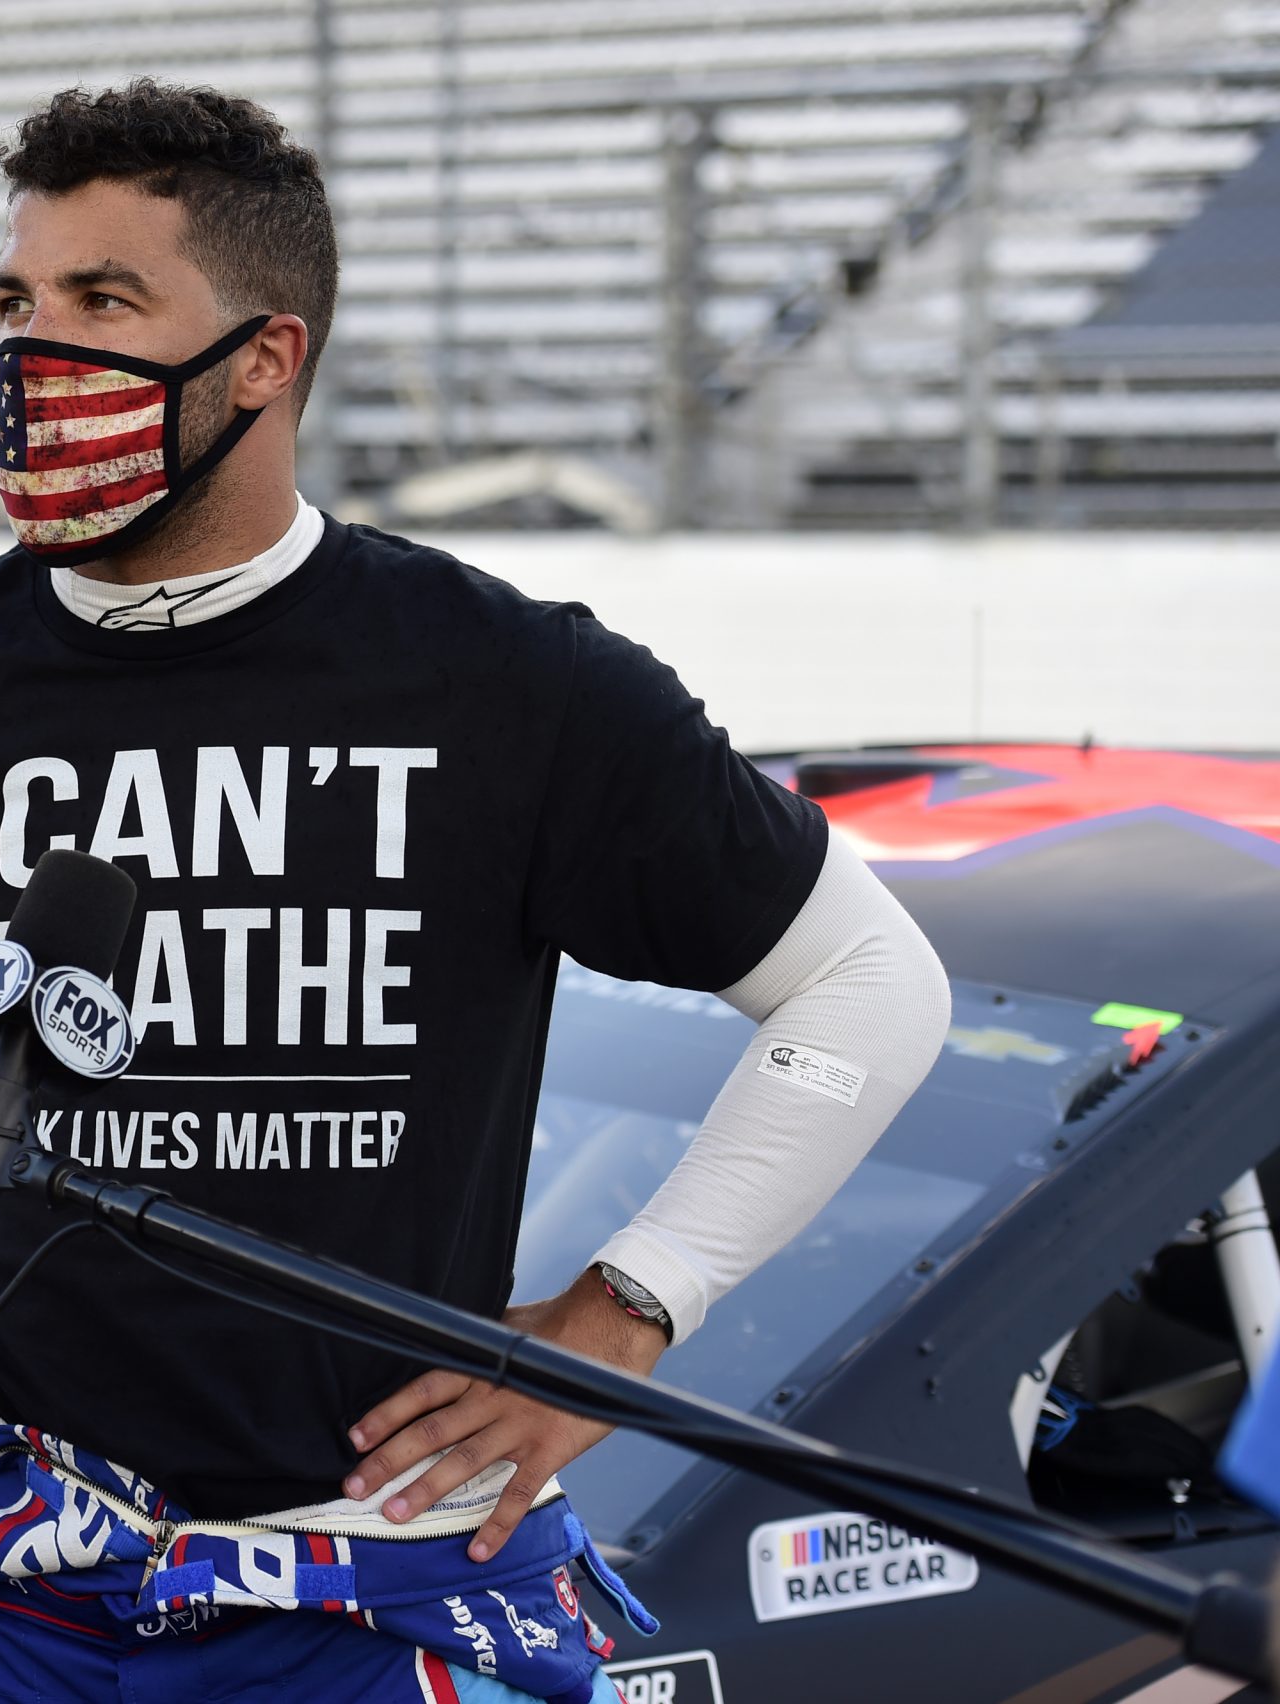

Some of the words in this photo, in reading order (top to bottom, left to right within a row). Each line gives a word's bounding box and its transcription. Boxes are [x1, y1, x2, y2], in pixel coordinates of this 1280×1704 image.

[0, 746, 438, 889] CAN'T
[46, 1013, 106, 1066] SPORTS
[53, 979, 121, 1050] FOX
[70, 1110, 201, 1169] LIVES
[215, 1110, 407, 1170] MATTER
[823, 1520, 937, 1562] NASC
[786, 1566, 870, 1604] RACE
[882, 1543, 946, 1587] CAR
